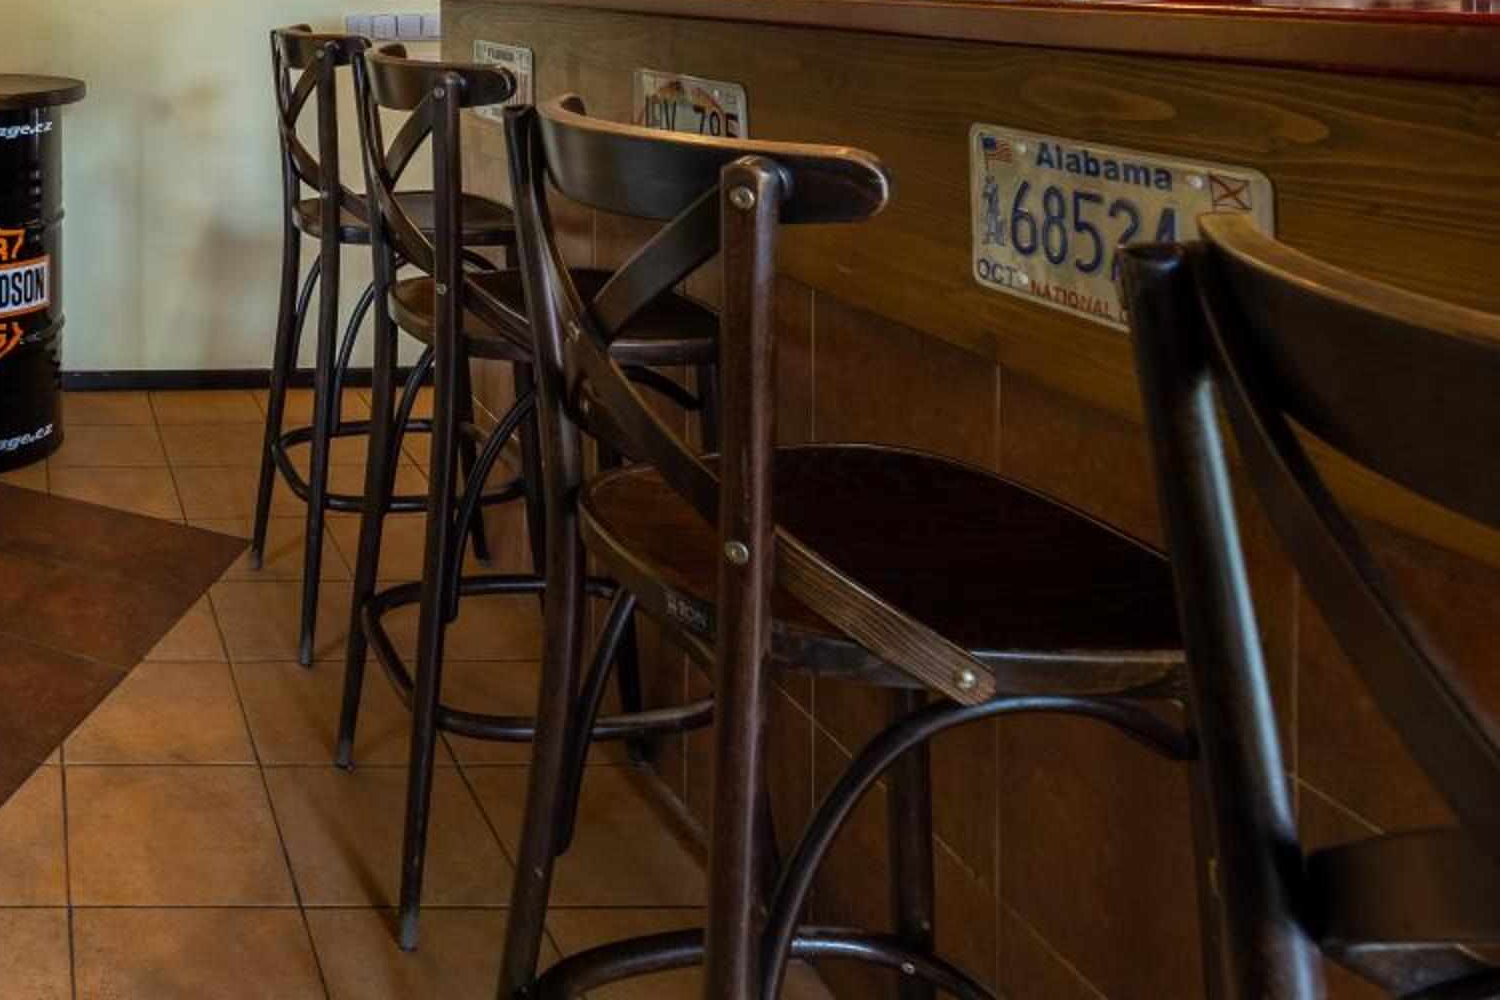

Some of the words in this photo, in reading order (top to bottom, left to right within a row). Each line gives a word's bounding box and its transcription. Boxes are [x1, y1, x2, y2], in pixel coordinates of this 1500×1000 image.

[1035, 141, 1173, 191] Alabama
[977, 258, 1016, 287] OCT
[1028, 279, 1112, 318] NATIONAL
